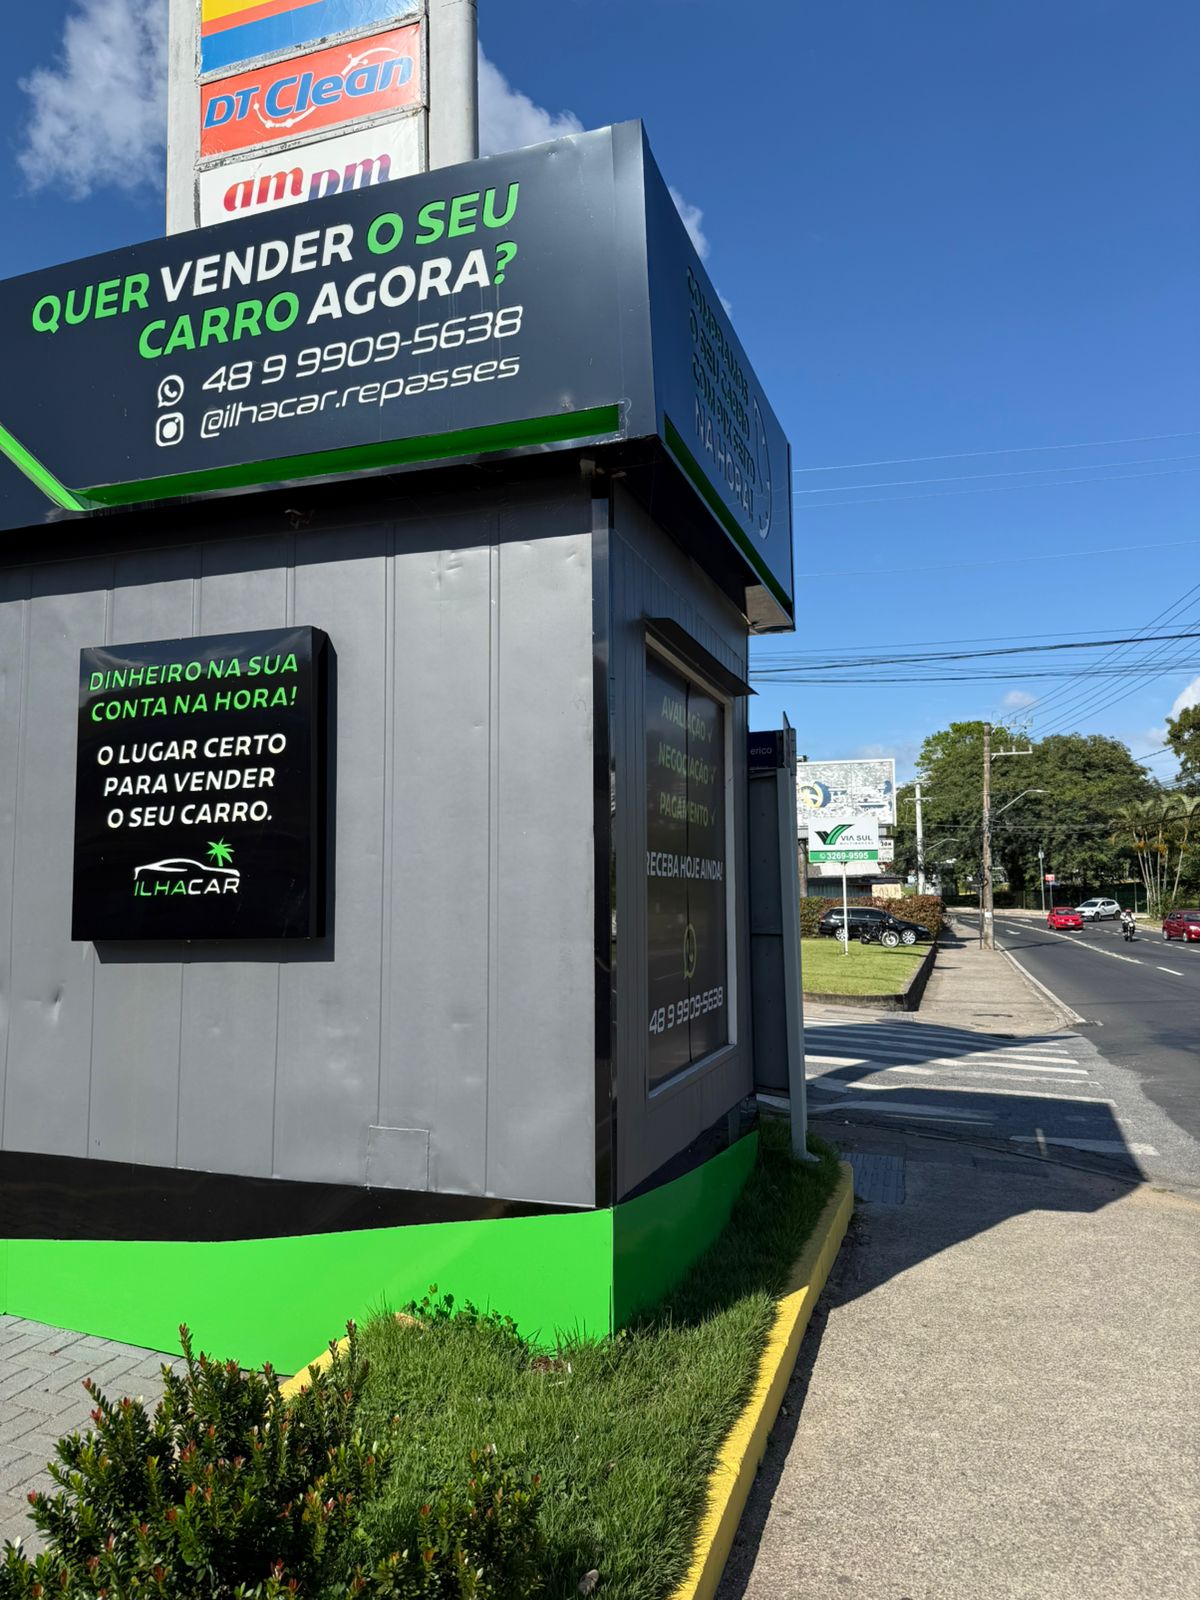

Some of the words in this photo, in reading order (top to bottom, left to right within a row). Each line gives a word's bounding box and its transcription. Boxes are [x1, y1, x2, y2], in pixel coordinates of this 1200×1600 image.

[204, 86, 260, 129] DT
[265, 55, 414, 118] Clean
[31, 272, 150, 335] QUER
[160, 223, 354, 303] VENDER
[366, 212, 404, 255] O
[415, 182, 520, 246] SEU
[138, 291, 300, 359] CARRO
[306, 241, 518, 324] AGORA?
[201, 359, 252, 394] 48
[262, 354, 287, 385] 9
[296, 305, 524, 378] 9909-5638
[200, 356, 520, 440] @ilhacar.repasses
[695, 393, 716, 464] NA
[88, 661, 201, 691] DINHEIRO
[207, 658, 241, 679] NA
[247, 653, 298, 676] SUA
[91, 696, 168, 722] CONTA
[173, 693, 208, 715] NA
[214, 686, 297, 711] HORA!
[97, 745, 114, 766] O
[118, 739, 197, 764] LUGAR
[203, 733, 287, 758] CERTO
[658, 742, 709, 785] NEGOCIAÇÃO
[103, 774, 168, 797] PARA
[174, 767, 275, 792] VENDER
[107, 808, 124, 828] O
[128, 805, 175, 827] SEU
[180, 800, 273, 825] CARRO.
[680, 855, 699, 879] HOJE
[826, 851, 869, 860] 3269-9595
[134, 878, 240, 896] ILHACAR
[649, 1007, 665, 1035] 48
[667, 1004, 675, 1029] 9
[676, 986, 723, 1025] 9909-5638
